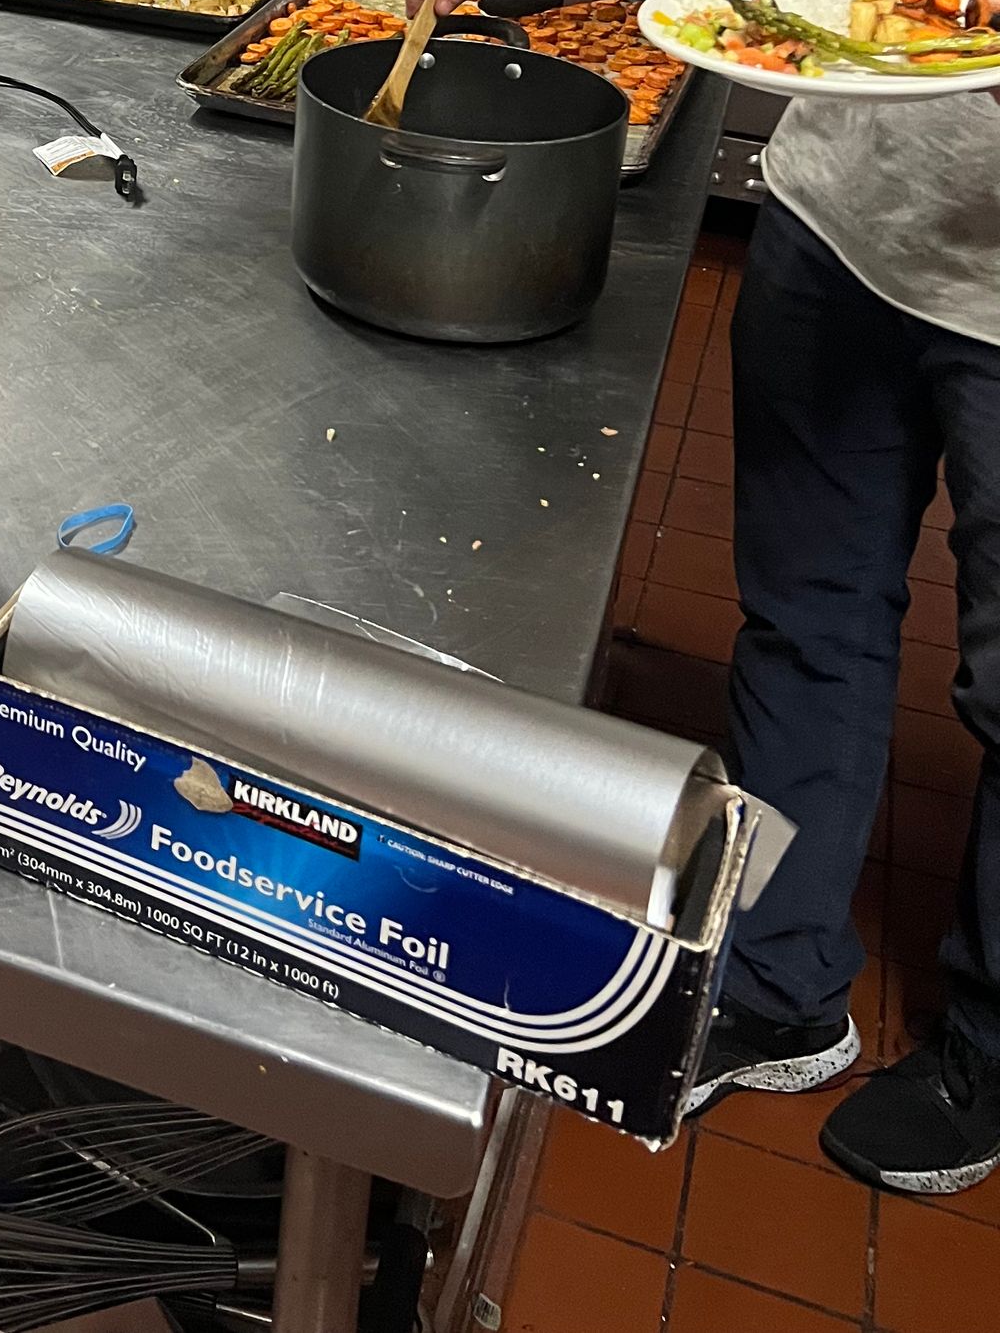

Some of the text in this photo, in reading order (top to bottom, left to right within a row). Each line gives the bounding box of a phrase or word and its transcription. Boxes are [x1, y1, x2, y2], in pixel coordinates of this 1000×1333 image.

[71, 725, 147, 773] Quality
[234, 780, 358, 844] KIRKLAND
[151, 823, 367, 934] Foodservice
[379, 917, 450, 970] Foil
[427, 855, 456, 871] SHARP
[456, 867, 490, 885] CUTTER
[490, 879, 514, 896] EDGE
[17, 852, 73, 885] (304mm
[75, 878, 84, 889] x
[87, 881, 142, 915] 304.8m)
[146, 906, 180, 930] 1000
[183, 921, 204, 942] SQ
[206, 932, 225, 948] FT
[226, 940, 249, 959] (12
[252, 951, 266, 967] in
[269, 960, 279, 973] x
[283, 964, 319, 989] 1000
[322, 980, 340, 998] ft)
[308, 918, 429, 976] Standard Aluminum Foil
[497, 1047, 625, 1123] RK611
